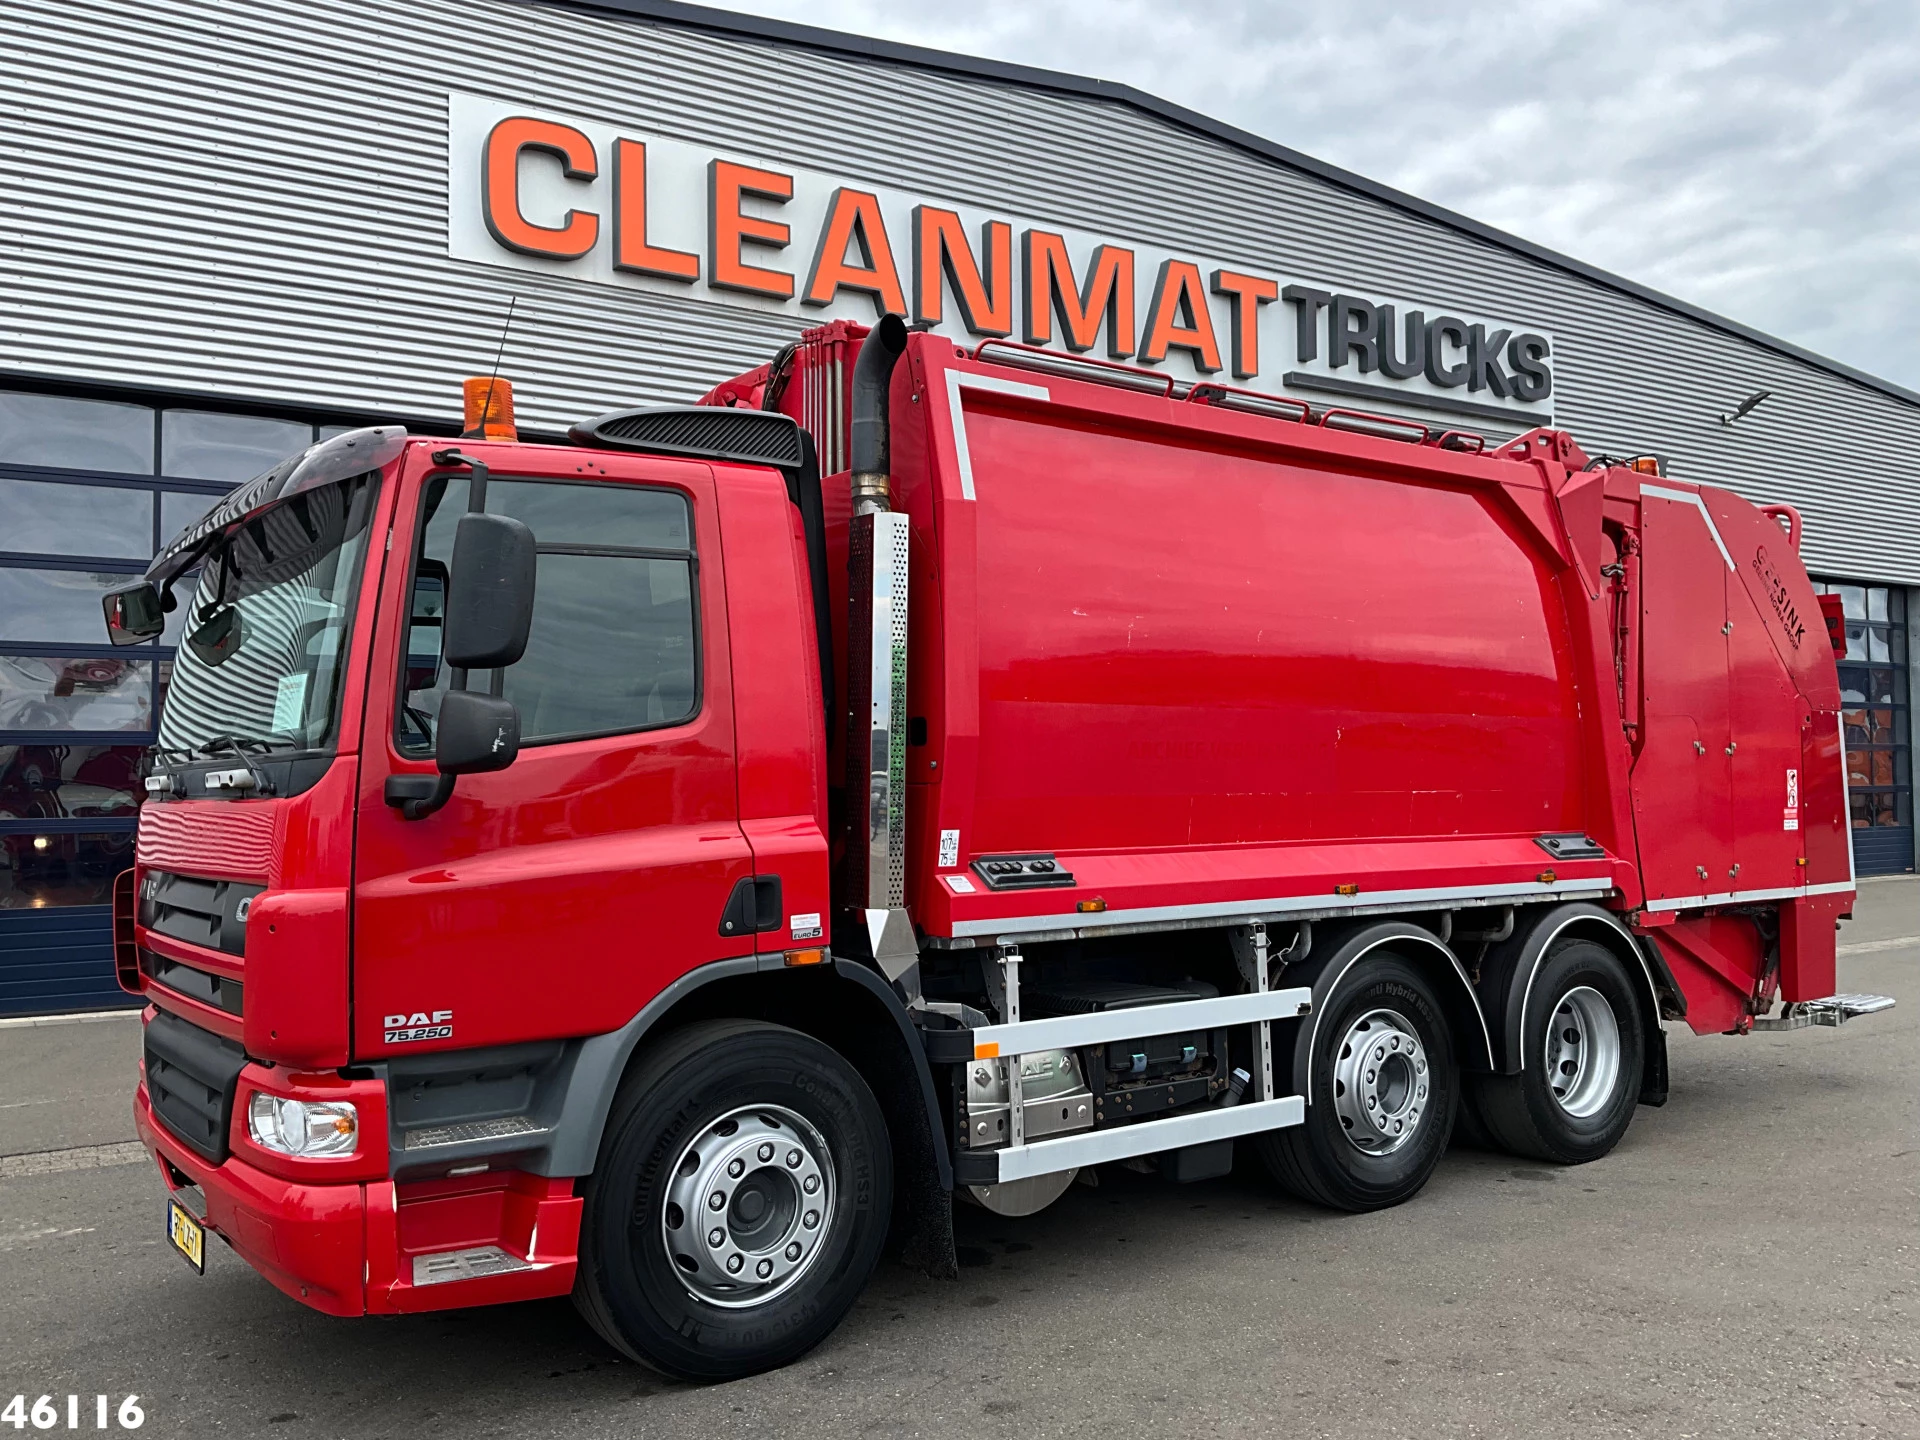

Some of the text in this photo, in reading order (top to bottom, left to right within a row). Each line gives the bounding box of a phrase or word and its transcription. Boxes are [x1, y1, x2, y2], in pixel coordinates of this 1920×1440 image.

[481, 115, 1553, 403] CLEANMAT TRUCKS
[793, 927, 822, 940] EURO 5
[1385, 982, 1418, 1003] Hybrid
[384, 1010, 453, 1028] DAF
[385, 1026, 452, 1042] 75.250
